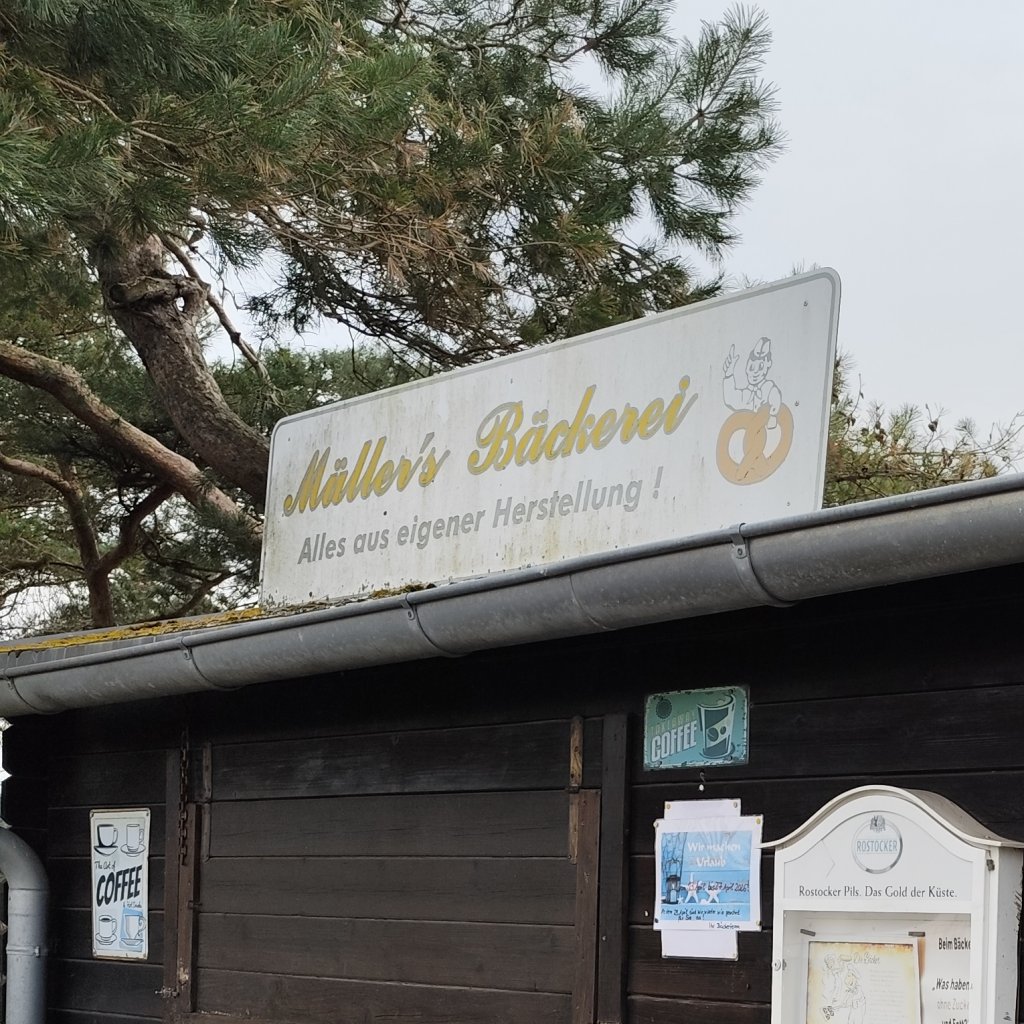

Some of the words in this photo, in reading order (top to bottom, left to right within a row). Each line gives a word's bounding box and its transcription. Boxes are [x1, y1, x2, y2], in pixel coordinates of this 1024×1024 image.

[467, 375, 698, 475] Bäckerei
[297, 532, 346, 564] Alles
[353, 528, 389, 554] aus
[397, 510, 486, 550] eigener
[492, 480, 642, 528] Herstellung
[652, 466, 664, 499] !
[651, 720, 698, 762] COFFEE
[856, 839, 898, 852] ROSTOCKER
[96, 864, 143, 907] COFFEE
[799, 885, 841, 897] Rostocker
[844, 885, 862, 897] Pils.
[865, 885, 882, 897] Das
[884, 885, 908, 897] Gold
[910, 886, 926, 898] der
[928, 885, 958, 898] Küste.
[938, 936, 953, 950] Beim
[950, 977, 970, 990] haben
